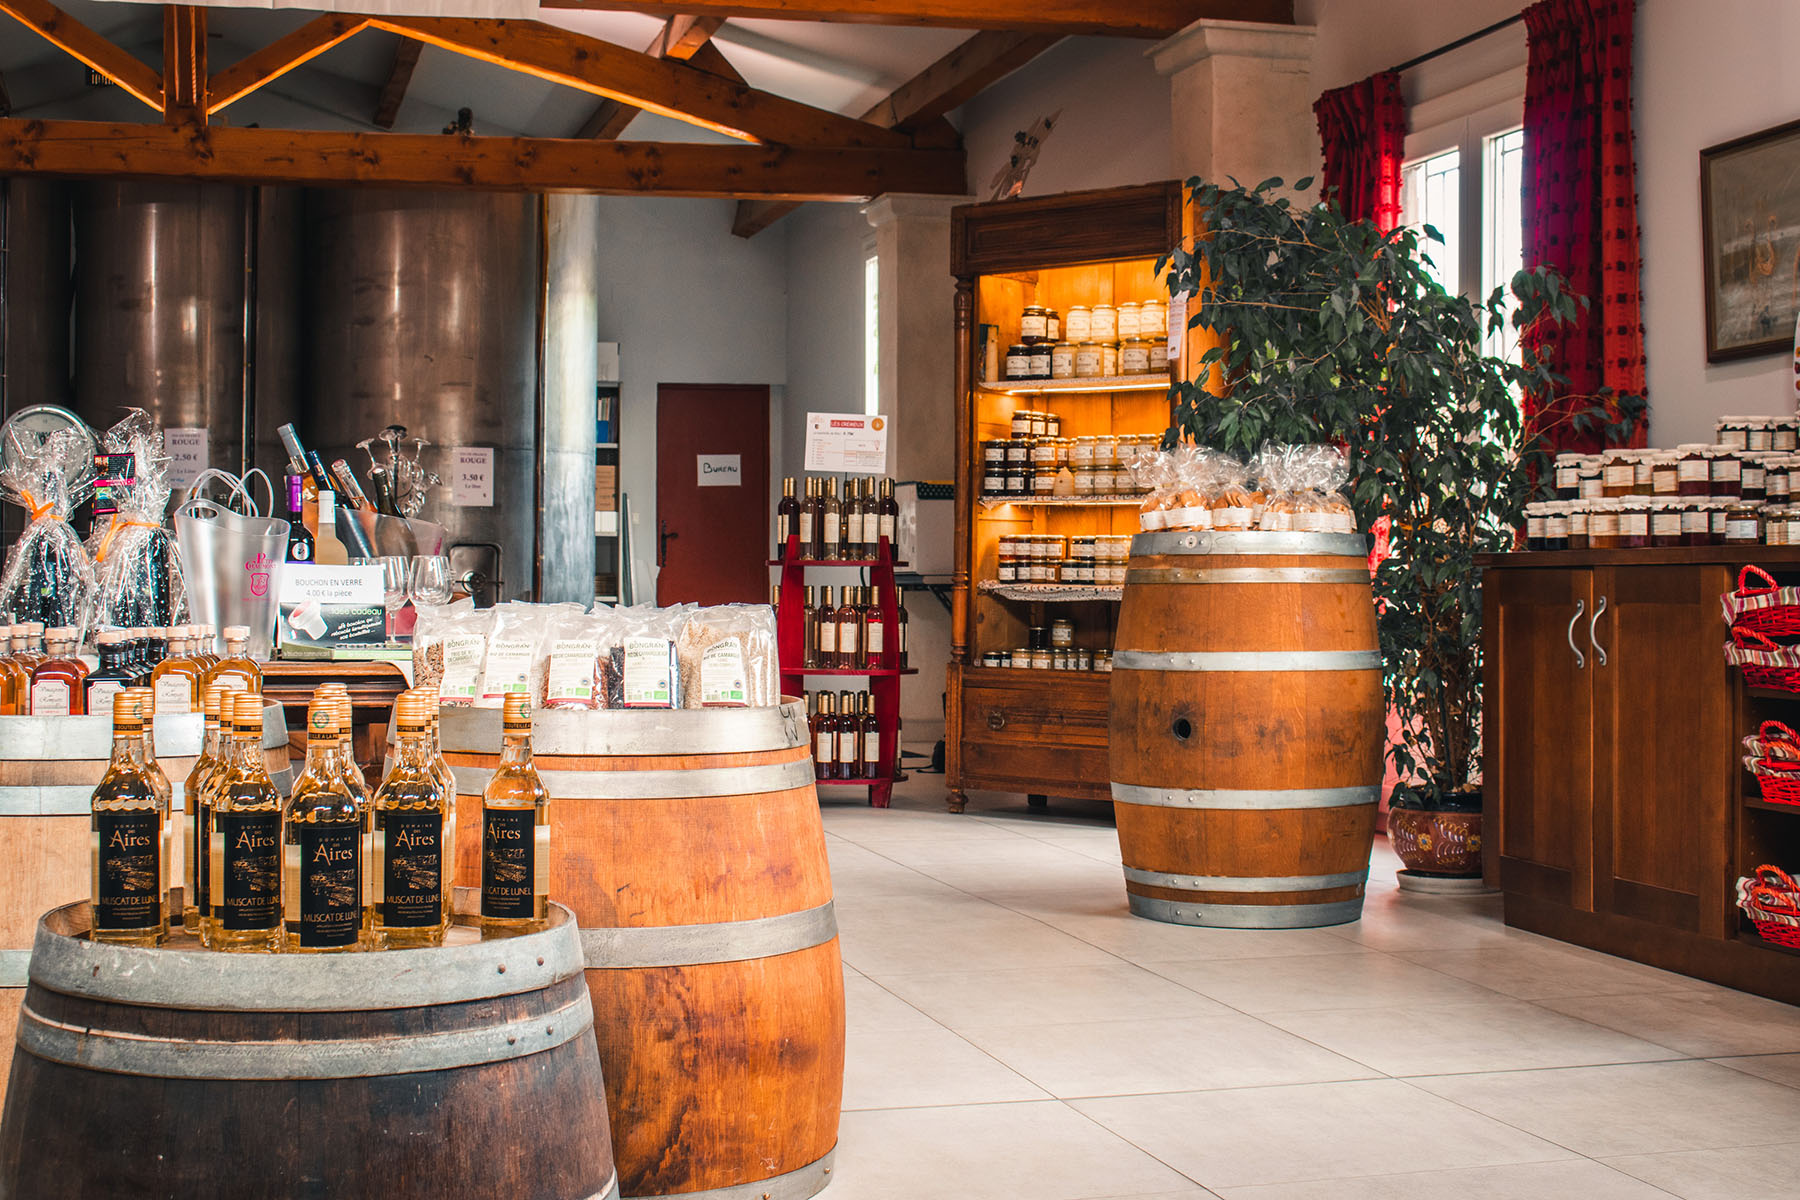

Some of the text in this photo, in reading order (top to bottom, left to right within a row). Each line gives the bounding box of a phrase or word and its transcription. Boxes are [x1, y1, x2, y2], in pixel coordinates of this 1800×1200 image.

[334, 590, 352, 598] pièce
[486, 822, 520, 844] Aires
[108, 830, 150, 852] Aires
[235, 831, 275, 852] Aires
[394, 829, 434, 851] Aires
[312, 843, 352, 866] Aires
[500, 887, 510, 895] DE
[510, 887, 532, 896] LUNEL
[102, 896, 129, 905] MUSCAT
[130, 896, 140, 904] DE
[226, 898, 256, 906] MUSCAT
[257, 898, 266, 906] DE
[386, 896, 414, 904] MUSCAT
[416, 896, 424, 904] DE
[304, 912, 334, 922] MUSCAT
[335, 912, 344, 921] DE
